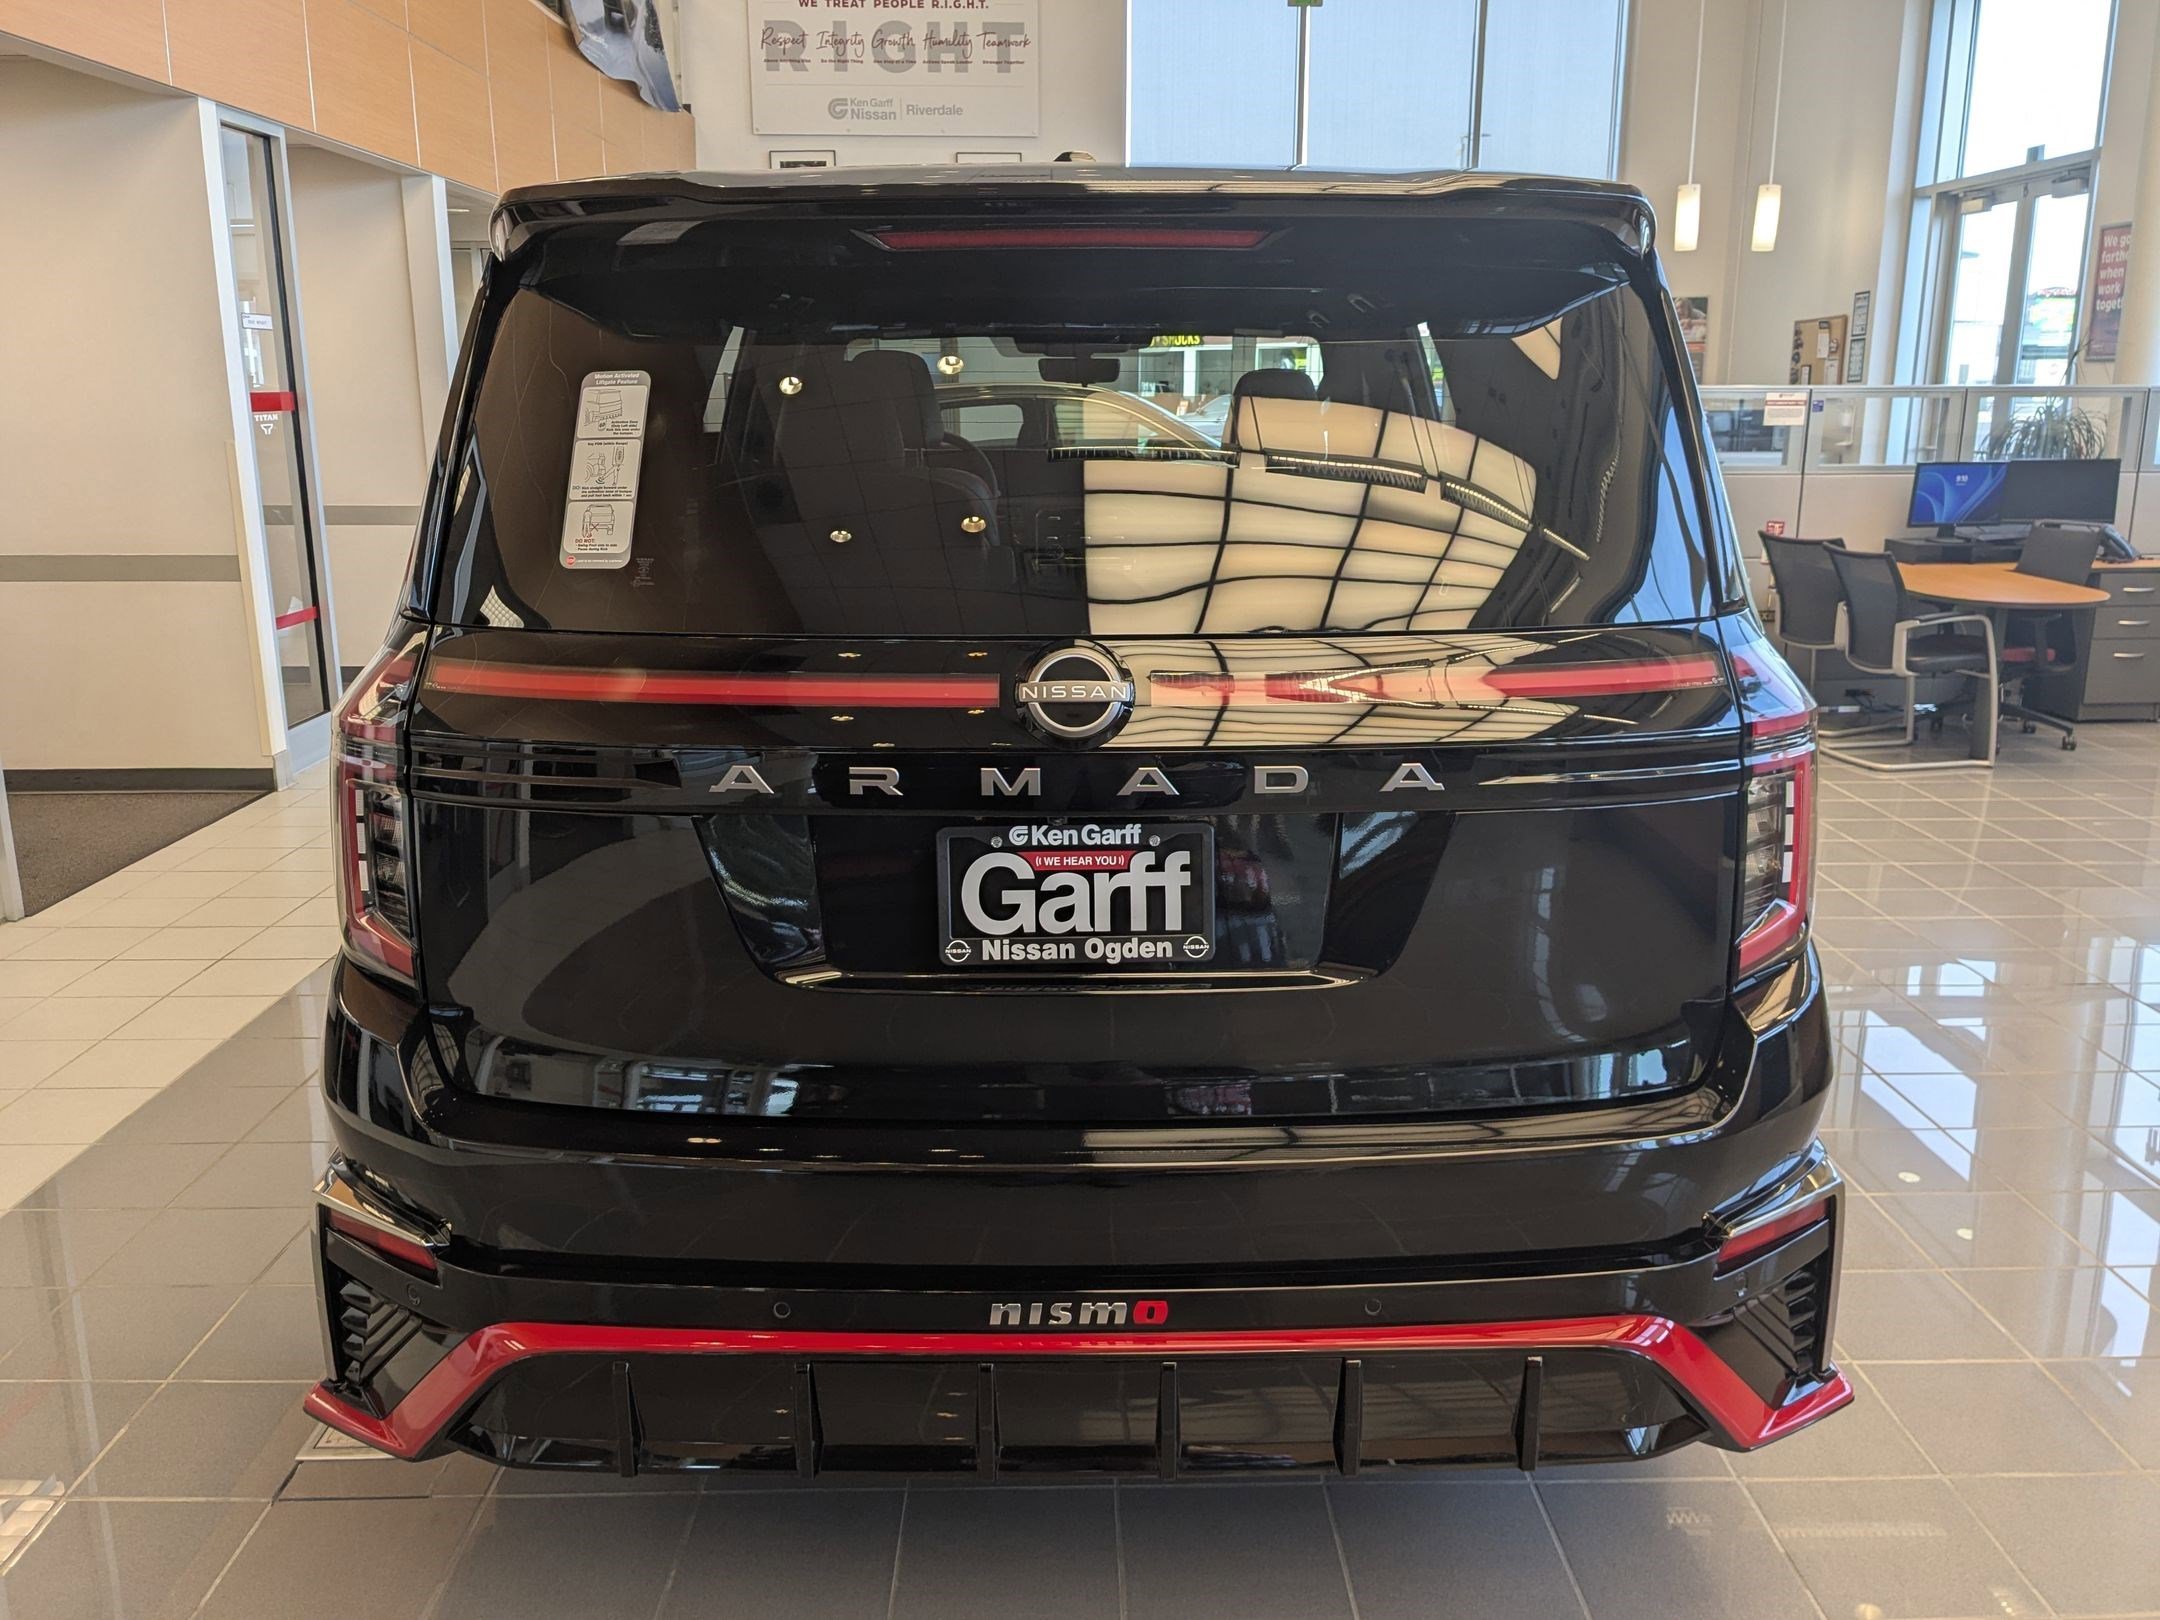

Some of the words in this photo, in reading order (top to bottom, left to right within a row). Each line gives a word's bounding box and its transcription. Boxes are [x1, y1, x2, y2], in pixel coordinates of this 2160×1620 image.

[799, 0, 818, 8] WE
[825, 0, 867, 8] TREAT
[873, 0, 925, 9] PEOPLE
[931, 0, 989, 9] R.I.G.H.T.
[760, 26, 809, 56] Respect
[815, 30, 865, 58] Integrity
[871, 28, 916, 50] Growth
[922, 29, 973, 60] Humility
[976, 31, 1032, 51] Teamwork
[850, 97, 869, 107] Ken
[869, 97, 894, 108] Garff
[906, 104, 964, 116] Riverdale
[850, 108, 897, 120] Nissan
[2103, 235, 2119, 248] We
[2099, 267, 2125, 279] when
[2097, 282, 2121, 295] work
[2095, 298, 2122, 313] toget
[1021, 685, 1126, 699] NISSAN
[708, 763, 1446, 796] ARMADA
[1031, 824, 1079, 846] Ken
[1081, 823, 1142, 846] Garff
[1043, 856, 1061, 866] WE
[1063, 856, 1093, 866] HEAR
[1095, 855, 1117, 866] YOU
[961, 850, 1191, 936] Garff
[982, 939, 1076, 961] Nissan
[1084, 937, 1173, 965] Ogden
[989, 1300, 1169, 1326] nismo
